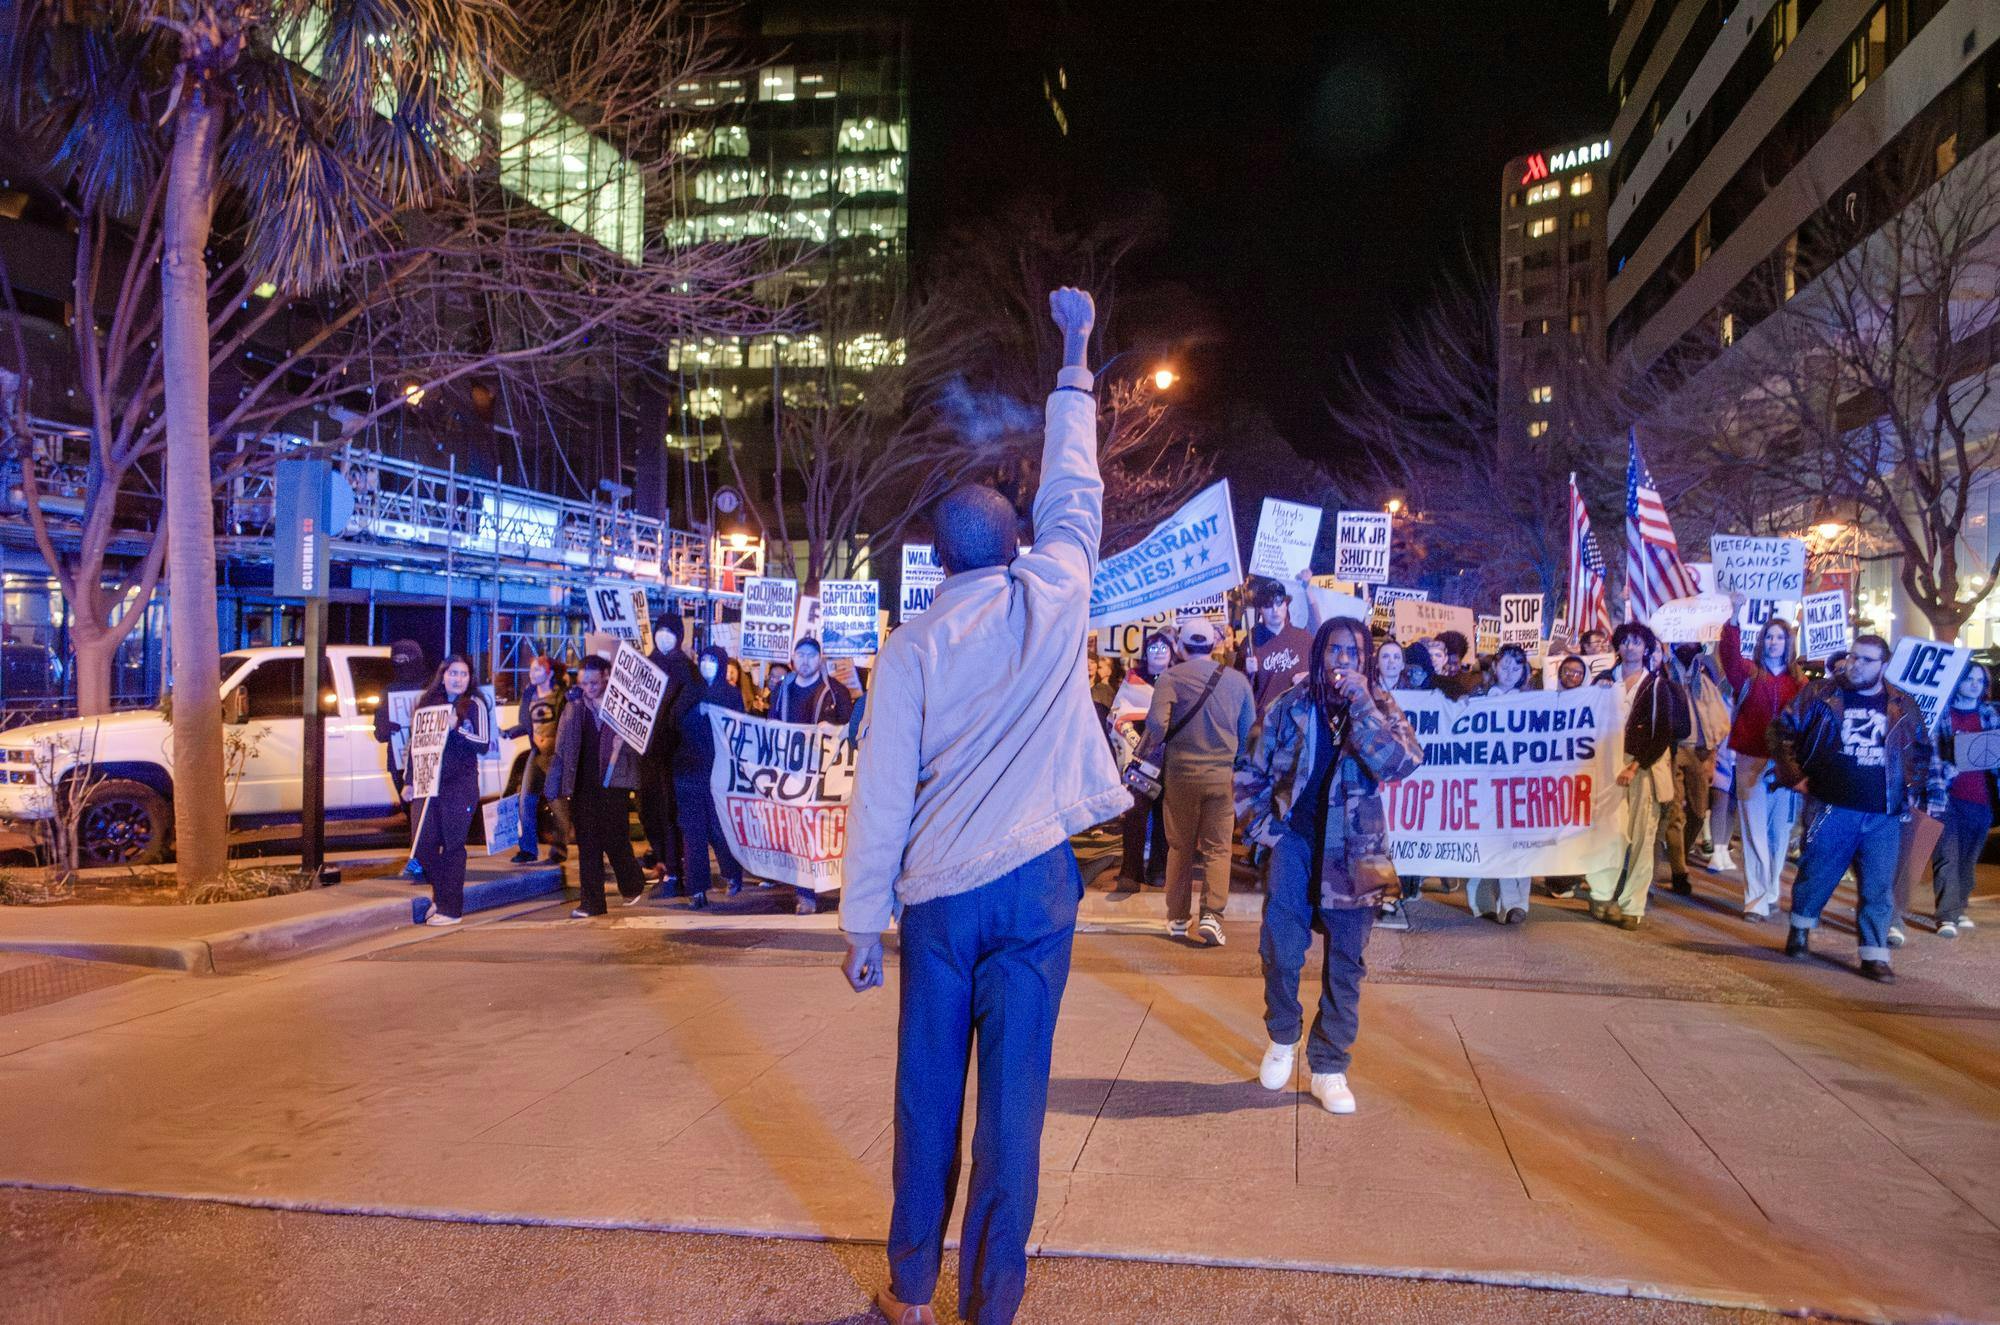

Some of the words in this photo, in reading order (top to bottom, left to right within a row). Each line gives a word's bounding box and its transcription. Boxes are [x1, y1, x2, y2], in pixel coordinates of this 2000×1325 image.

[1340, 526, 1367, 544] MLK
[1368, 526, 1386, 545] JR
[1713, 538, 1791, 556] VETERANS
[302, 535, 313, 591] COLUMBIA
[1340, 548, 1372, 567] SHUT
[1374, 549, 1386, 568] IT
[1725, 555, 1791, 569] AGAINST
[1338, 566, 1384, 574] DOWN!
[1717, 569, 1766, 593] RACIST
[595, 588, 627, 621] ICE
[746, 584, 793, 603] COLUMBIA
[822, 591, 877, 605] CAPITALISM
[903, 587, 934, 611] JAN
[745, 602, 792, 618] MINNEAPOLIS
[822, 604, 840, 617] HAS
[840, 604, 876, 617] OUTLIVED
[1175, 605, 1225, 614] NOW!
[1504, 598, 1540, 624] STOP
[1807, 604, 1828, 624] MLK
[1829, 603, 1842, 620] JR
[744, 621, 791, 632] STOP
[1502, 629, 1513, 641] ICE
[1514, 629, 1539, 641] TERROR
[1808, 624, 1834, 644] SHUT
[1834, 623, 1844, 639] IT
[743, 632, 756, 648] ICE
[757, 633, 790, 650] TERROR
[617, 649, 663, 697] COLUMBIA
[1899, 643, 1956, 688] ICE
[614, 666, 657, 711] MINNEAPOLIS
[609, 684, 653, 723] STOP
[416, 709, 449, 734] DEFEND
[604, 694, 617, 717] ICE
[616, 704, 649, 740] TERROR
[1451, 706, 1596, 735] COLUMBIA
[721, 716, 753, 764] THE
[754, 723, 832, 775] WHOLE
[1421, 736, 1596, 766] MINNEAPOLIS
[727, 758, 756, 795] IS
[1379, 779, 1435, 832] TOP
[1439, 777, 1480, 831] ICE
[1490, 774, 1592, 829] TERROR
[1434, 841, 1481, 863] DEFENSA
